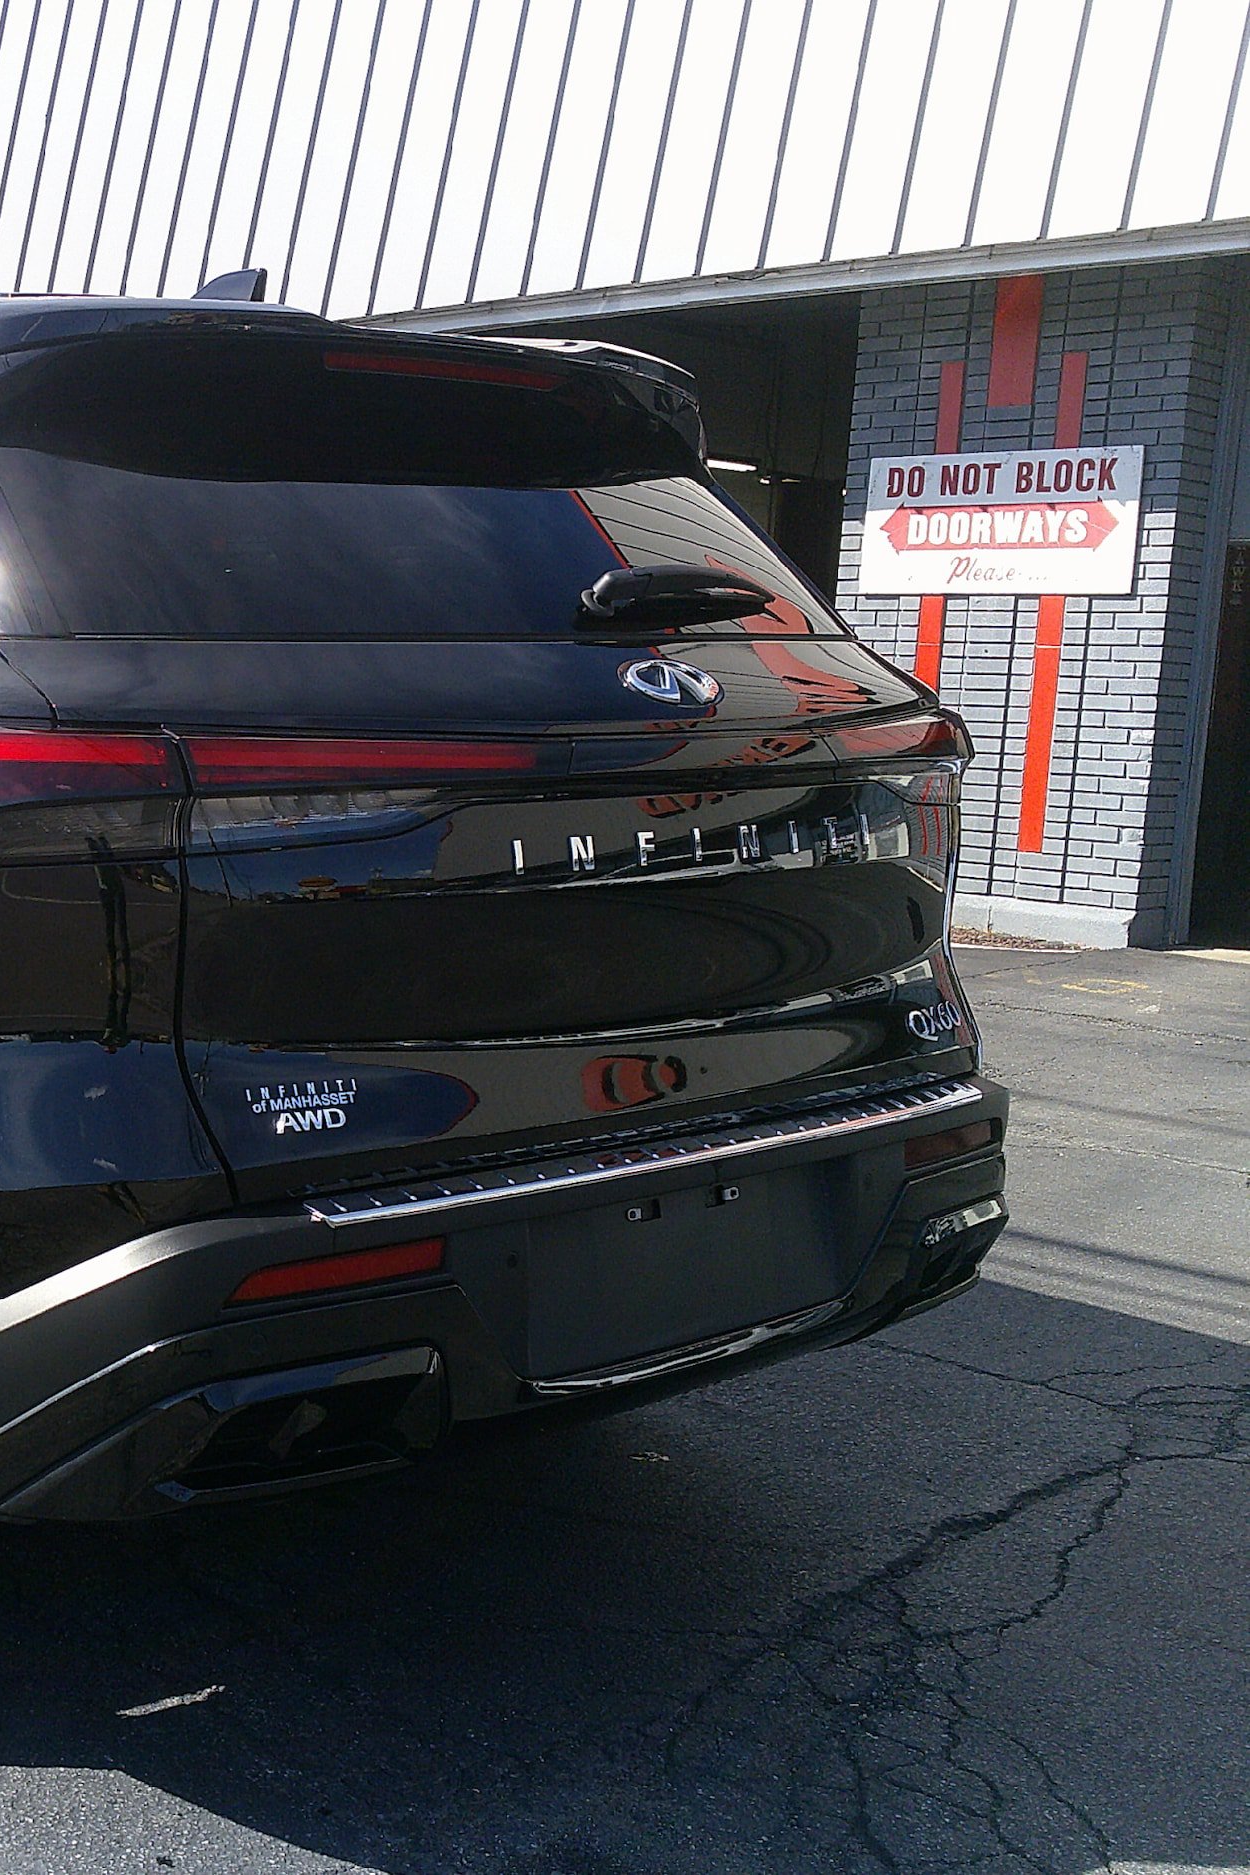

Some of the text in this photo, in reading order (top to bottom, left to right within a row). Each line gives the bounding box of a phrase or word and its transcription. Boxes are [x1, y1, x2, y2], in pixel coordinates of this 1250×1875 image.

[886, 457, 1119, 498] DO NOT BLOCK
[906, 508, 1089, 546] DOORWAYS
[511, 813, 871, 877] INFINITI
[908, 1001, 962, 1042] QX60
[246, 1079, 357, 1102] INFINITI
[252, 1091, 356, 1114] of MANHASSET
[276, 1108, 347, 1135] AWD
